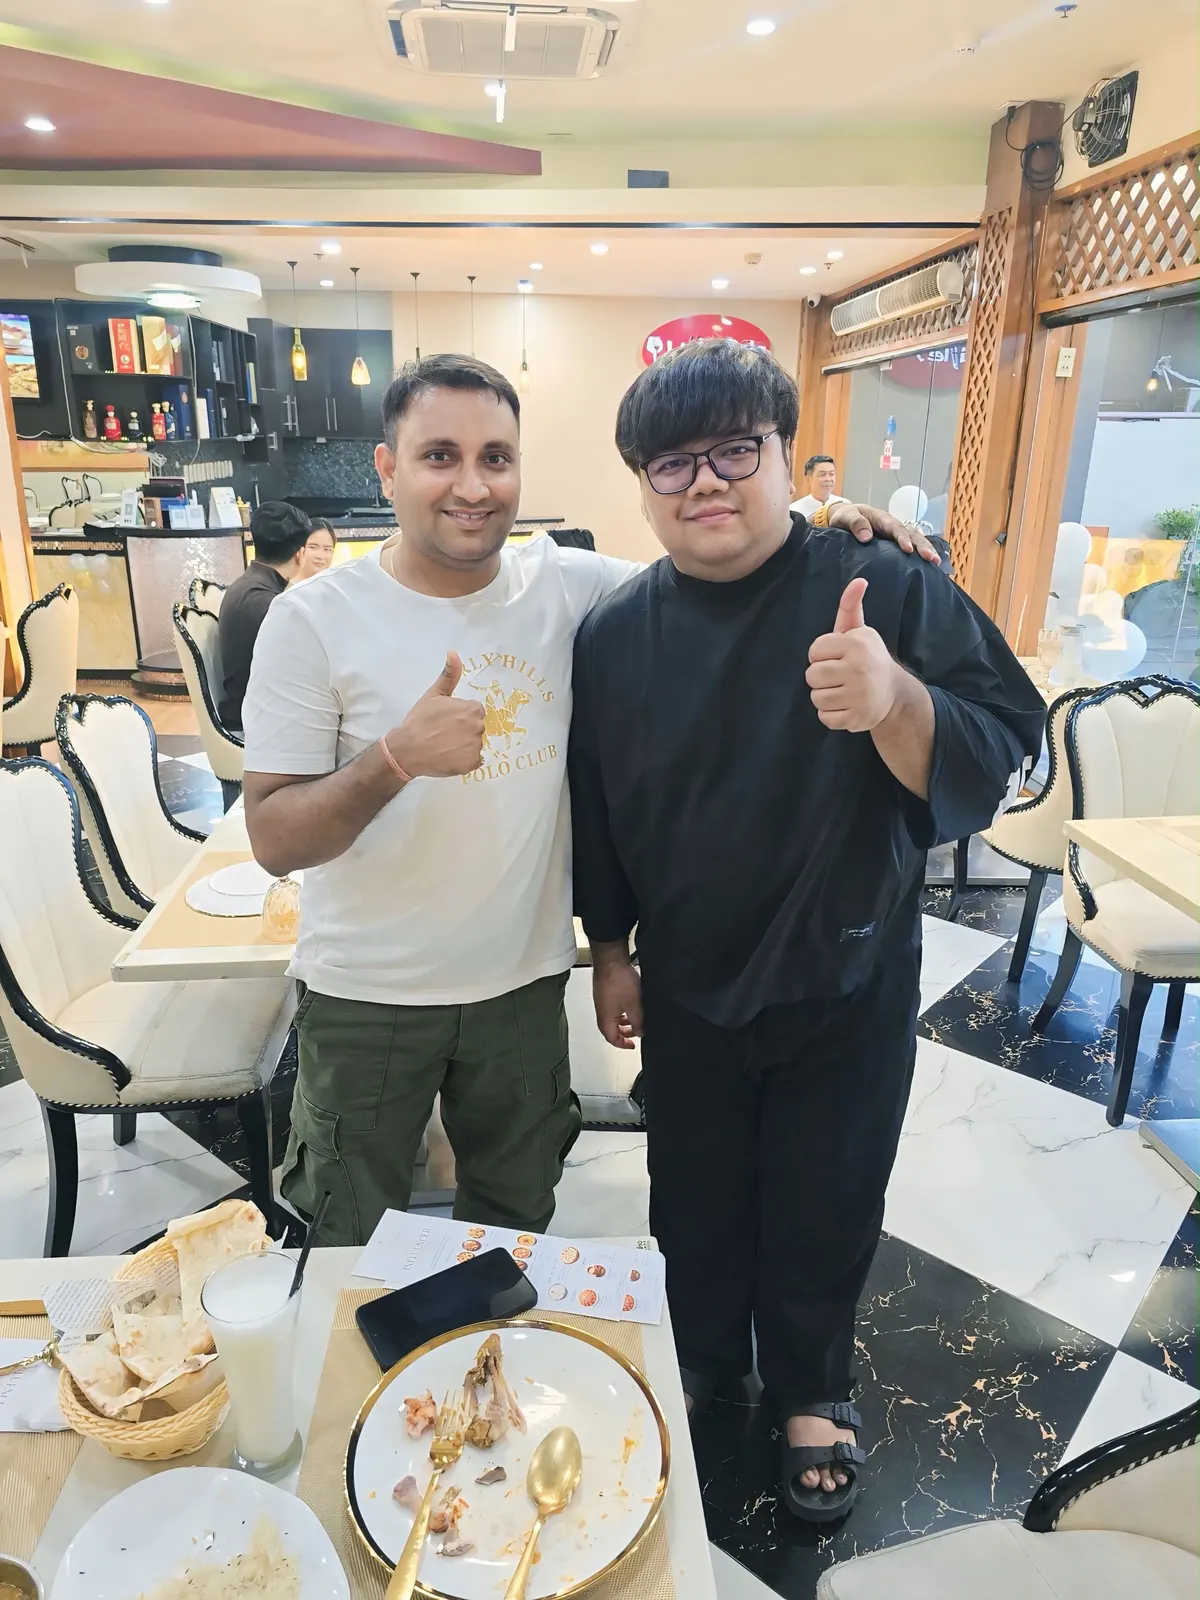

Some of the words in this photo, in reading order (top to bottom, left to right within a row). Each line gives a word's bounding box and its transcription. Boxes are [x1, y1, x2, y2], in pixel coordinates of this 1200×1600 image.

[502, 654, 555, 704] HILLS
[461, 760, 511, 786] POLO
[515, 744, 558, 771] CLUB
